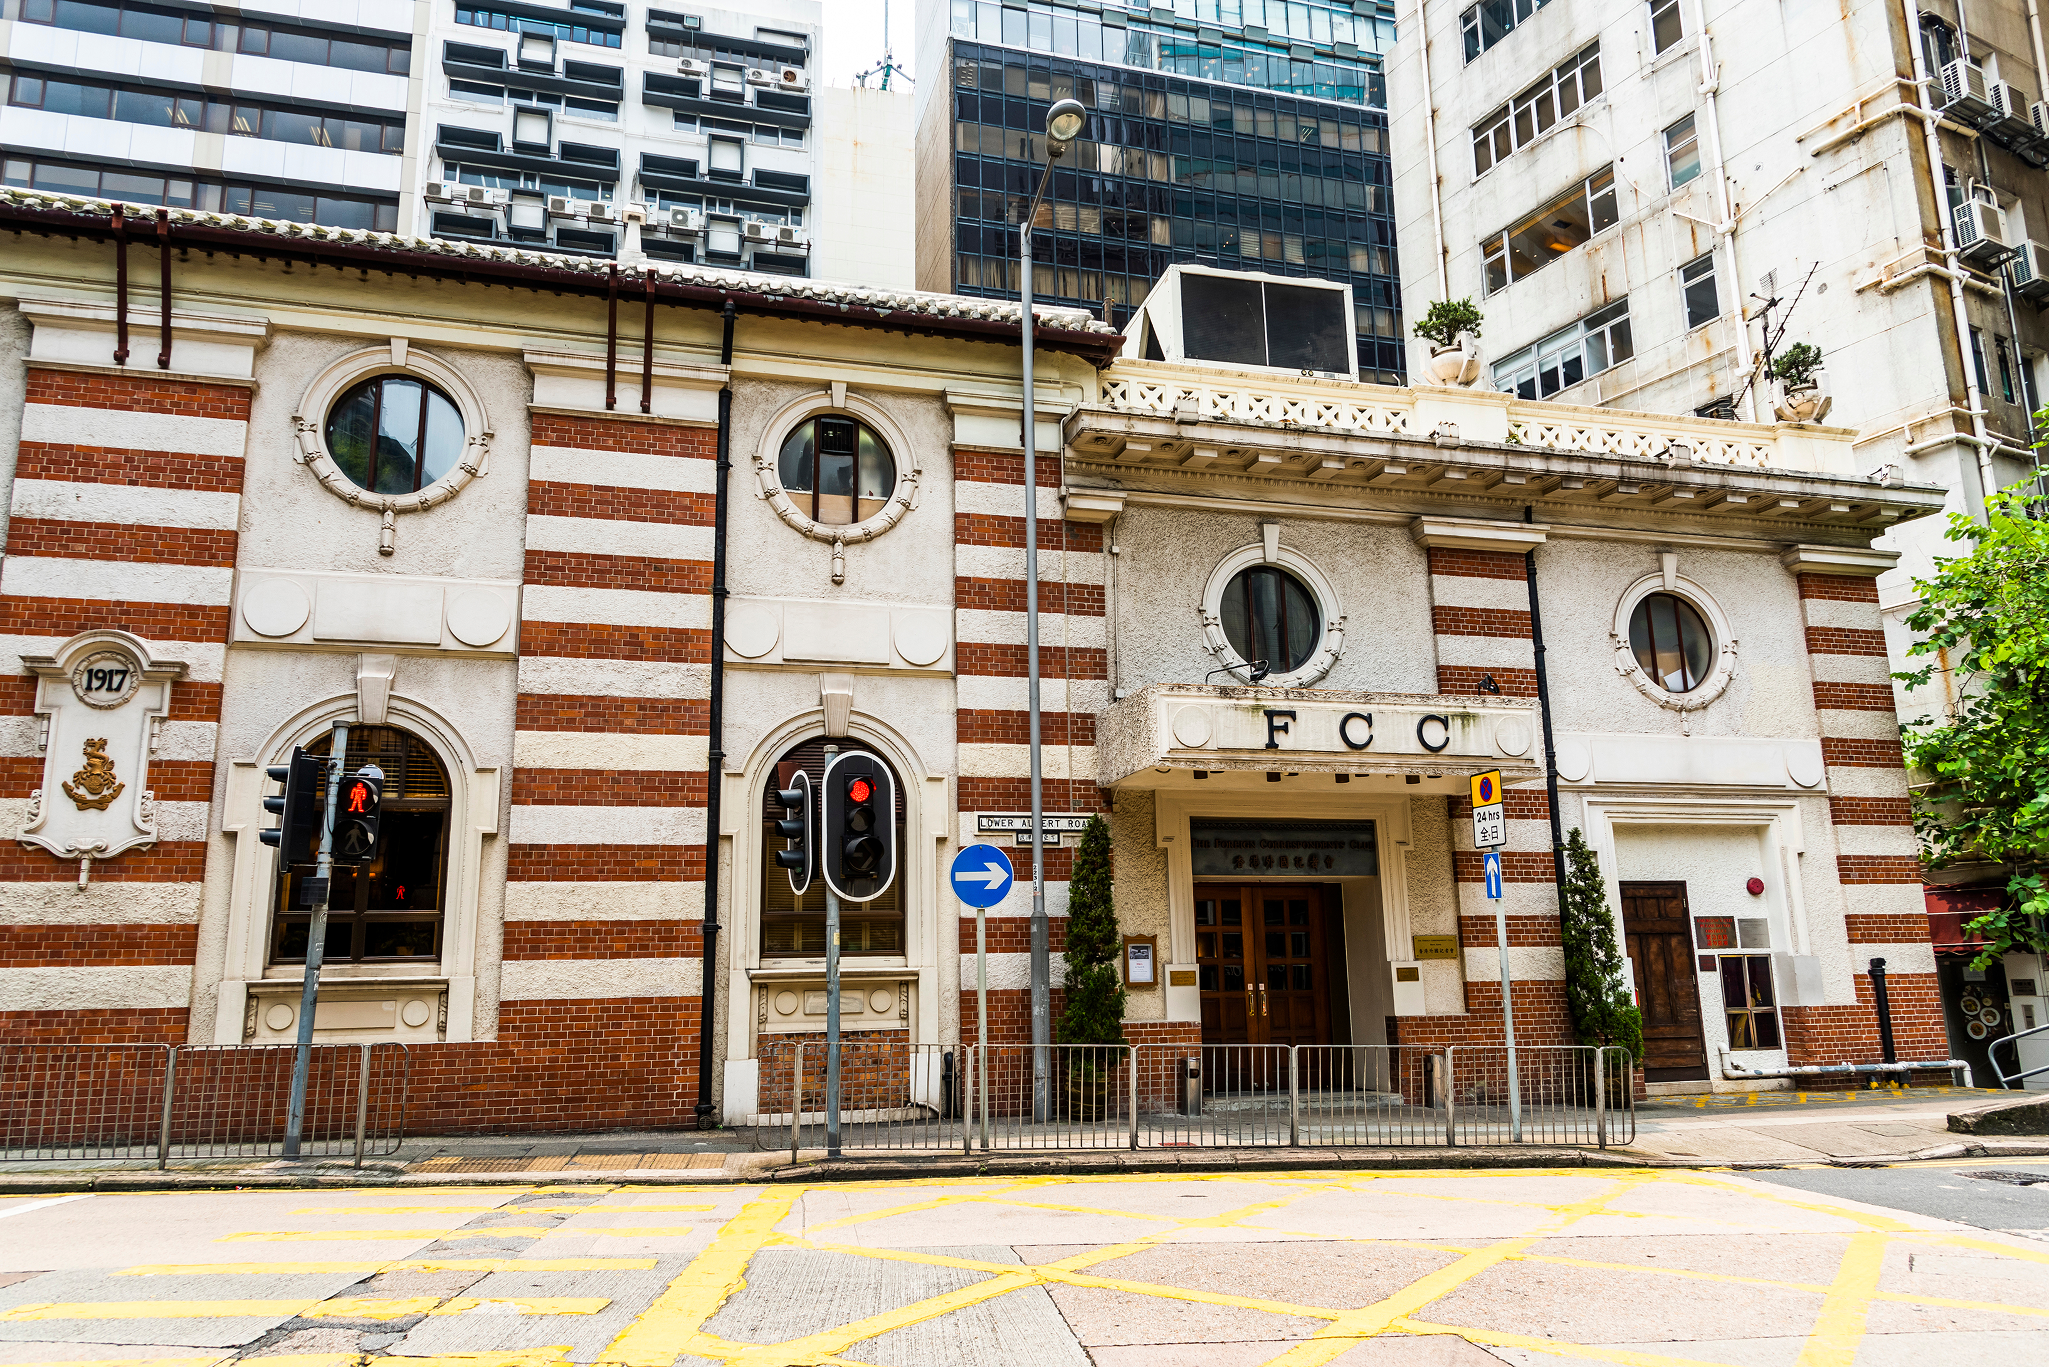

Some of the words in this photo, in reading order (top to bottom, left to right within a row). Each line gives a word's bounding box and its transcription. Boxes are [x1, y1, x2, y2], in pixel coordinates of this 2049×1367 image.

[84, 668, 129, 692] 1917
[980, 819, 1014, 828] LOWER
[1021, 819, 1060, 828] ALERT
[1068, 819, 1087, 828] ROA
[1477, 811, 1487, 823] 24
[1488, 810, 1500, 821] hrs
[1481, 825, 1498, 842] 全日
[1214, 838, 1256, 849] FOREIGN
[1233, 854, 1335, 869] 香港外國記者會
